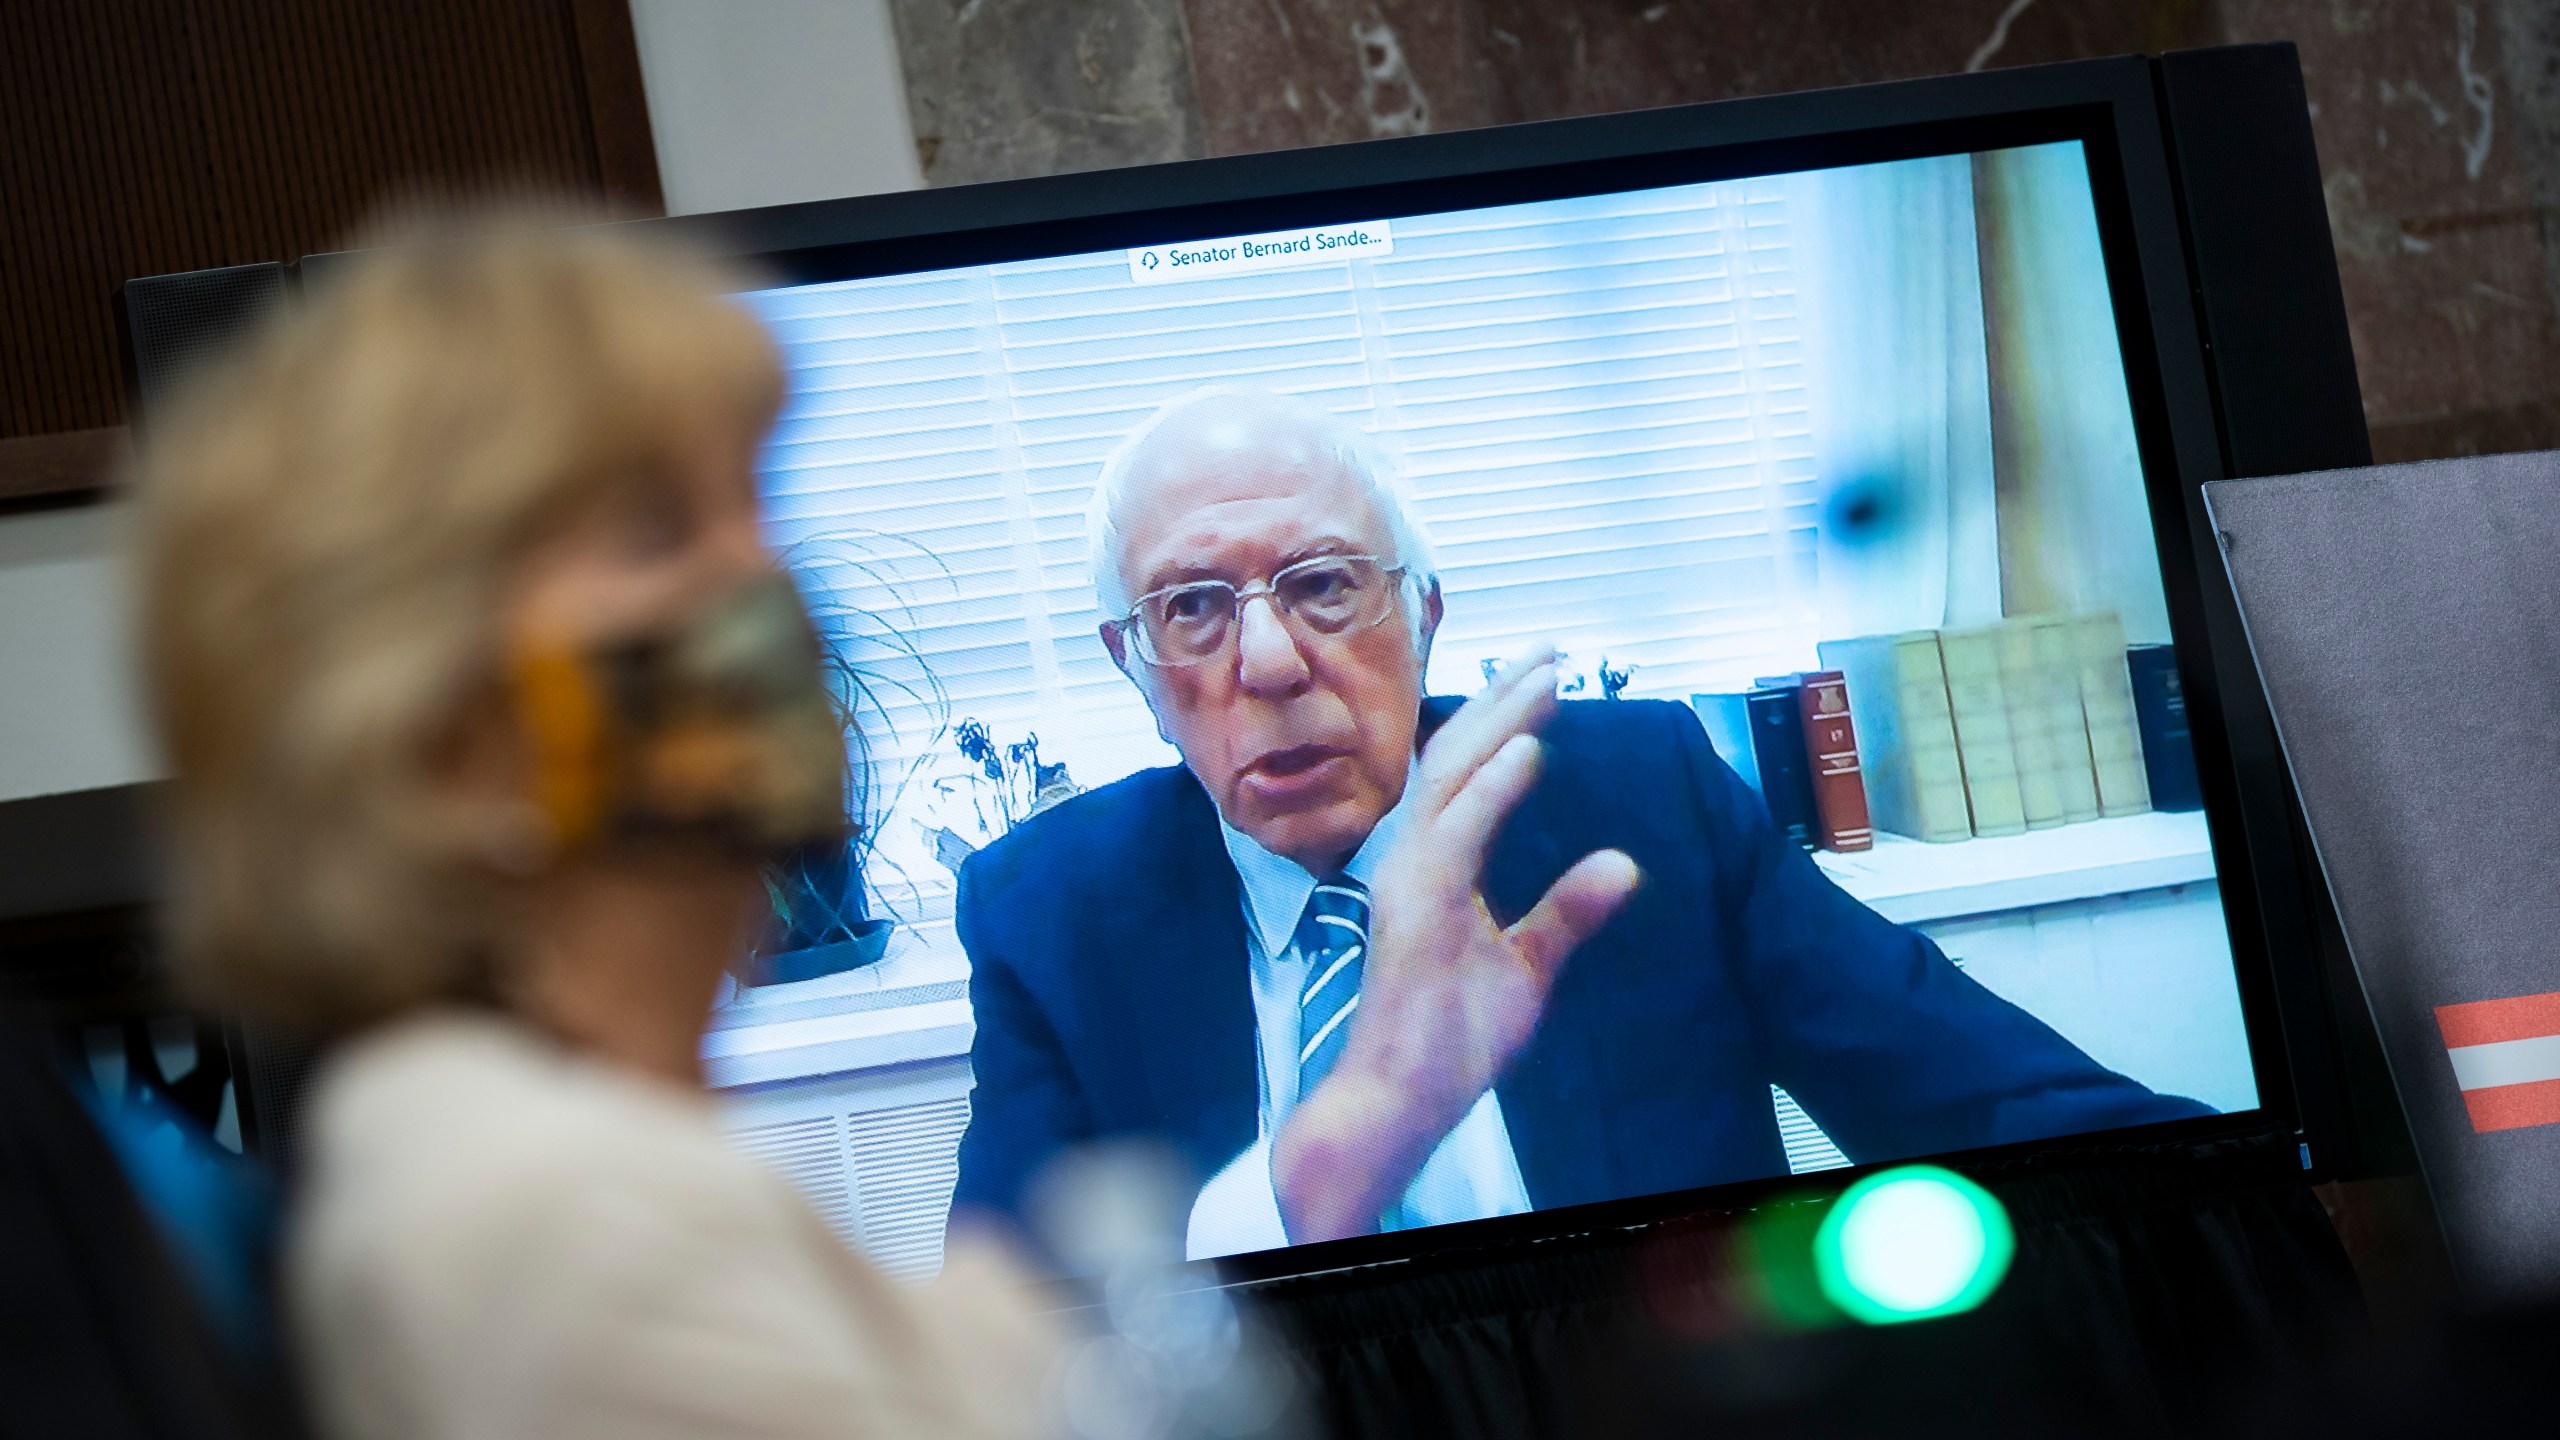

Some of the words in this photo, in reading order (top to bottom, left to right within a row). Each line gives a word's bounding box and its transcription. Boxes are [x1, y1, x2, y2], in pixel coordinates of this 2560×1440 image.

[1170, 246, 1236, 266] Senator
[1243, 236, 1310, 258] Bernard
[1316, 230, 1382, 250] Sande...
